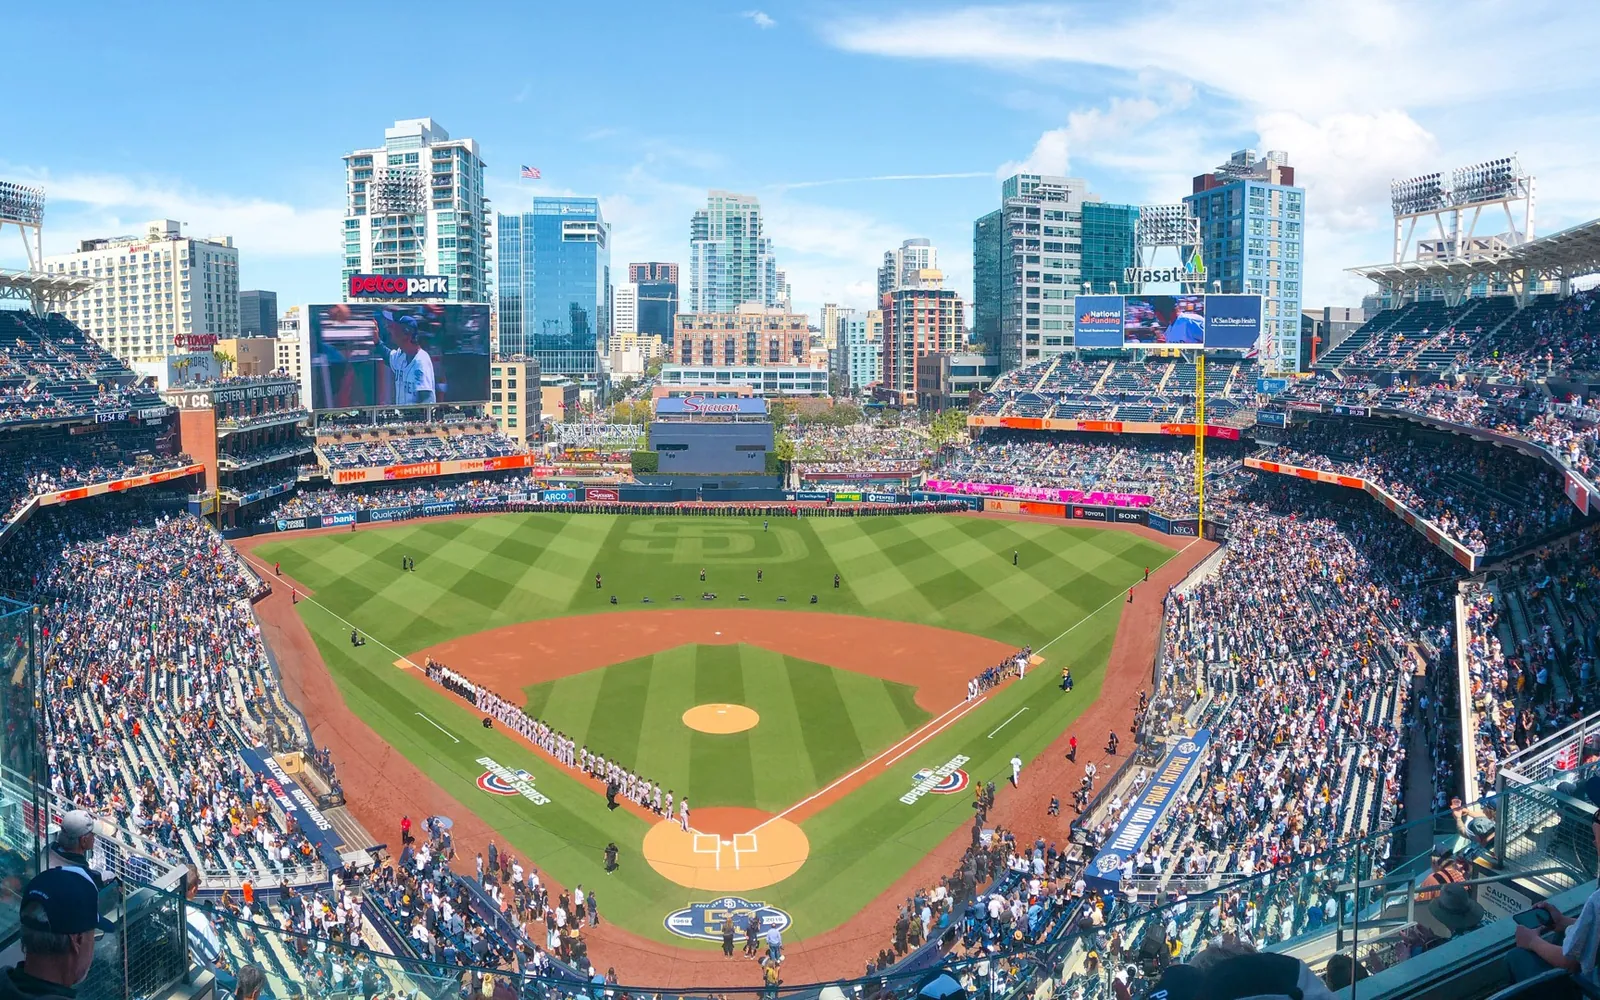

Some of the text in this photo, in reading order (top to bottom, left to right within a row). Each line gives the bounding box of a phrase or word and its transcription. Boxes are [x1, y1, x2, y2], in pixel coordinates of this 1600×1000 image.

[1126, 267, 1180, 283] Viasat
[1091, 317, 1120, 325] Funding
[1228, 317, 1241, 325] Diego
[187, 334, 218, 345] TOYOTA
[214, 390, 246, 404] WESTERN
[246, 387, 266, 399] METAL
[267, 385, 287, 397] SUPPLY
[683, 395, 741, 417] Sycuan
[1173, 526, 1195, 535] NECA
[262, 757, 292, 786] WELCOME
[475, 756, 551, 806] OPENING SERIES
[899, 754, 970, 805] OPENING SERIES
[291, 789, 332, 831] BIENVENIDOS
[1111, 756, 1192, 851] THANK YOU FRIAR FAITHFUL
[724, 899, 736, 909] SD
[1486, 886, 1522, 910] CAUTION
